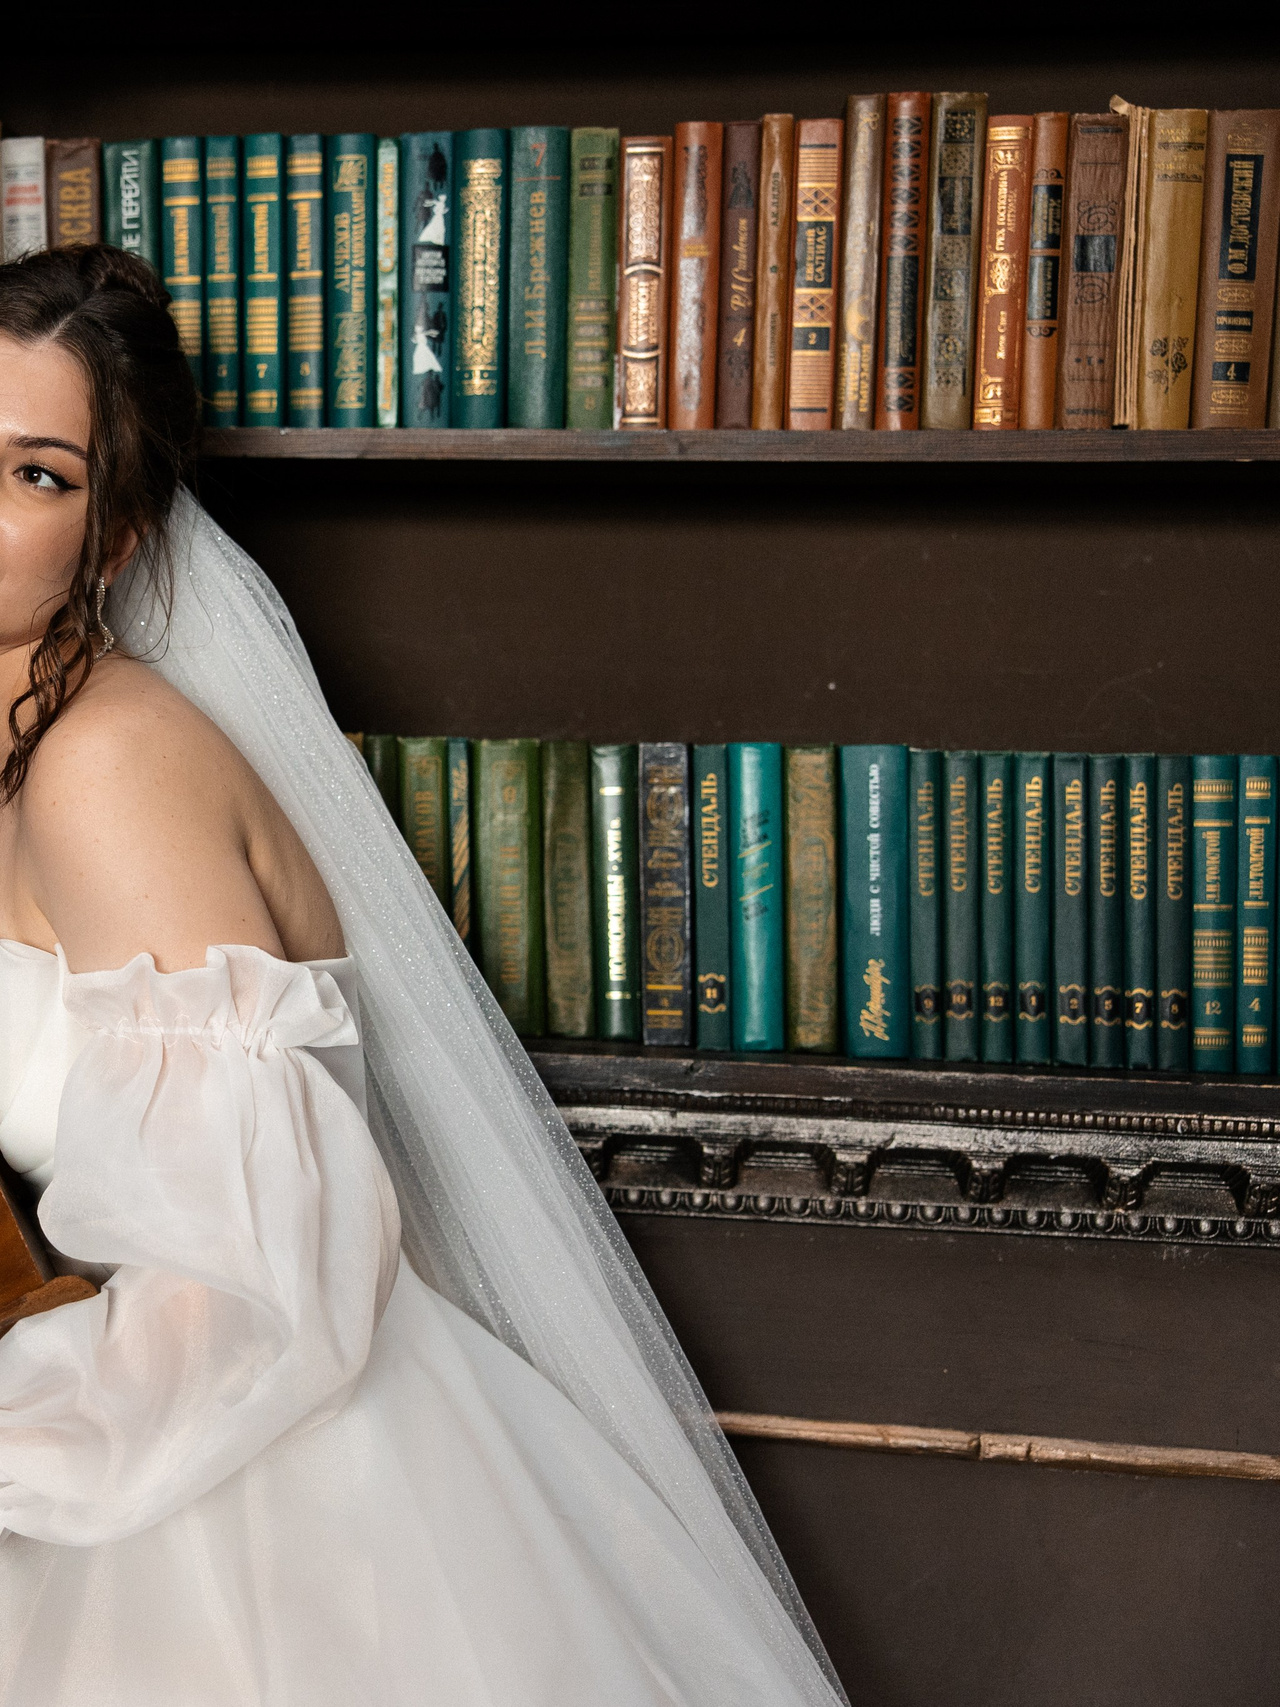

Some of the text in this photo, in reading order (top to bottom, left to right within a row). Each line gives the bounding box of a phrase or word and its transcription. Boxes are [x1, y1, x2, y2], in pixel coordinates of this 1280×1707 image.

[59, 167, 92, 247] ОСКВА
[256, 362, 269, 379] 7
[701, 773, 721, 887] СТЕНДАЛЬ
[918, 781, 935, 896] СТЕНДАЛЬ
[950, 776, 968, 892] СТЕНДАЛЬ
[986, 778, 1005, 894] СТЕНДАЛЬ
[1025, 776, 1044, 893] СТЕНДАЛЬ
[1065, 779, 1083, 896] СТЕНДАЛЬ
[1100, 779, 1117, 897] СТЕНДАЛЬ
[1129, 782, 1149, 900] СТЕНДАЛЬ
[1167, 783, 1185, 900] СТЕНДАЛЬ
[1205, 1000, 1222, 1015] 12
[1248, 996, 1261, 1012] 4
